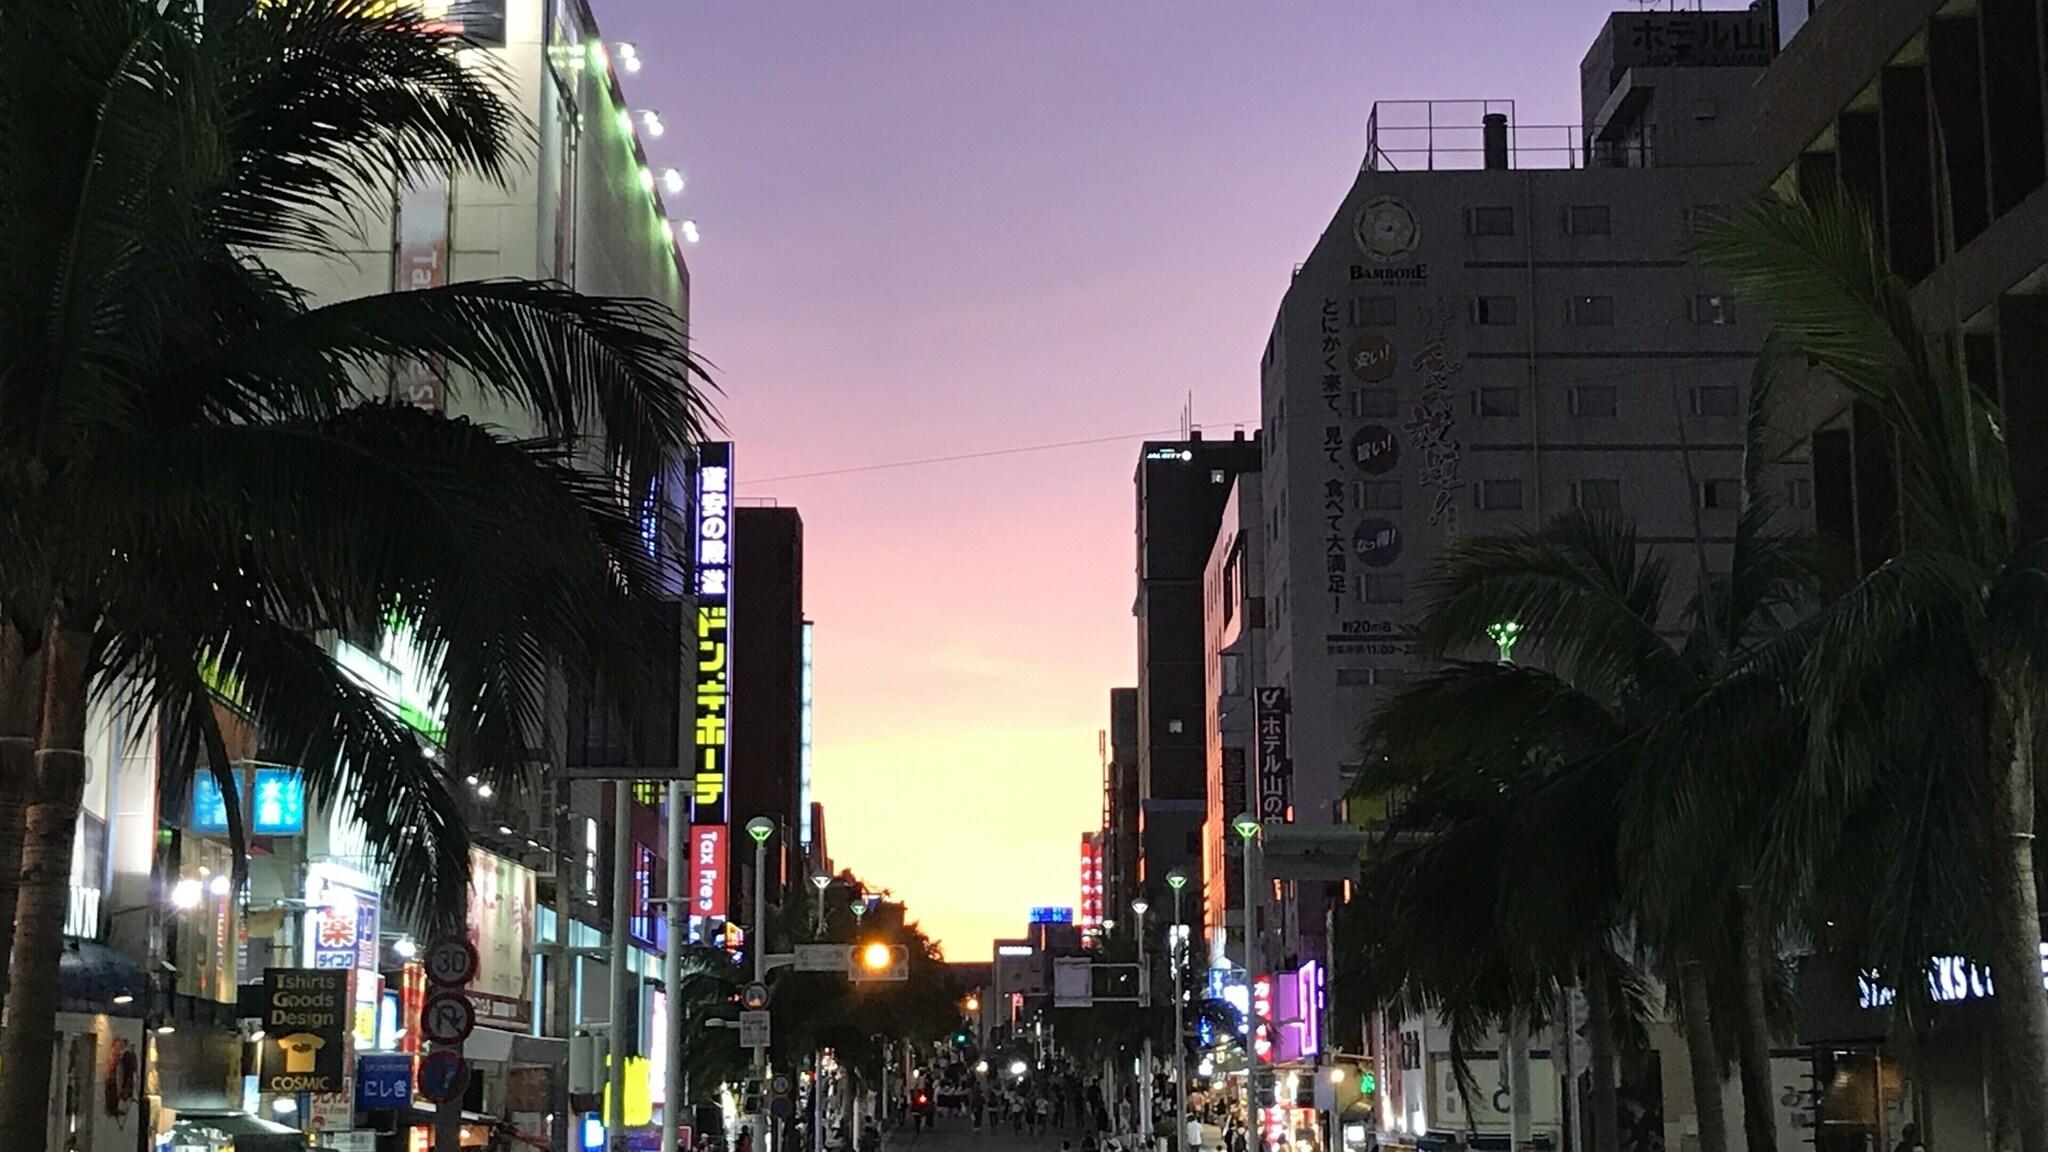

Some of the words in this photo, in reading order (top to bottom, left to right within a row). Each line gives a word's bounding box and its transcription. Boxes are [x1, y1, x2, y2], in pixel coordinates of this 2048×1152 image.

[411, 251, 437, 291] Ta
[699, 831, 719, 865] Tax
[698, 869, 717, 912] Free
[318, 952, 354, 968] ダイコク
[436, 951, 467, 974] 30
[275, 974, 336, 990] Tshirts
[272, 991, 335, 1008] Goods
[271, 1009, 335, 1028] Design
[271, 1075, 330, 1091] COSMIC
[364, 1079, 408, 1098] にしき
